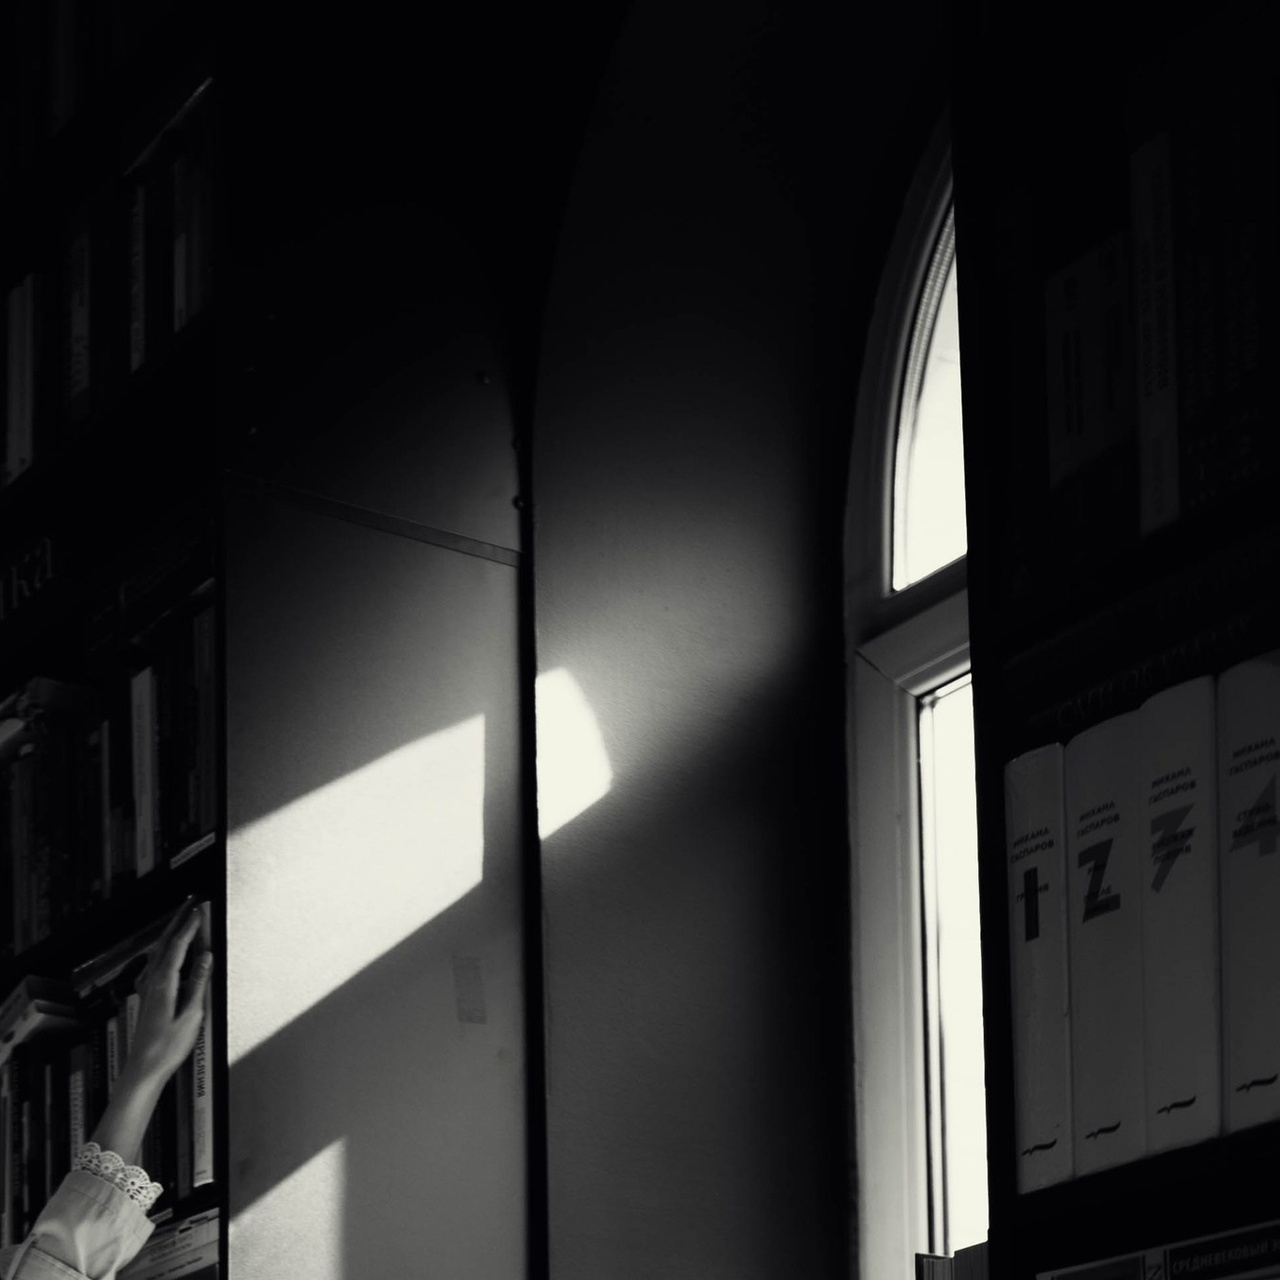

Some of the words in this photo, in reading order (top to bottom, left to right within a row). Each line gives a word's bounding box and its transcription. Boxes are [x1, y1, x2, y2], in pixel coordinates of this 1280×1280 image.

[1232, 737, 1275, 759] МИХАИЛ
[1229, 751, 1280, 776] ГАСПАРОВ
[1151, 767, 1191, 789] МИХАИЛ
[1149, 780, 1196, 805] ГАСПАРОВ
[1079, 801, 1115, 823] МИХАИЛ
[1229, 774, 1280, 857] 4
[1077, 813, 1120, 840] ГАСПАРОВ
[1010, 839, 1054, 864] ГАСПАРОВ
